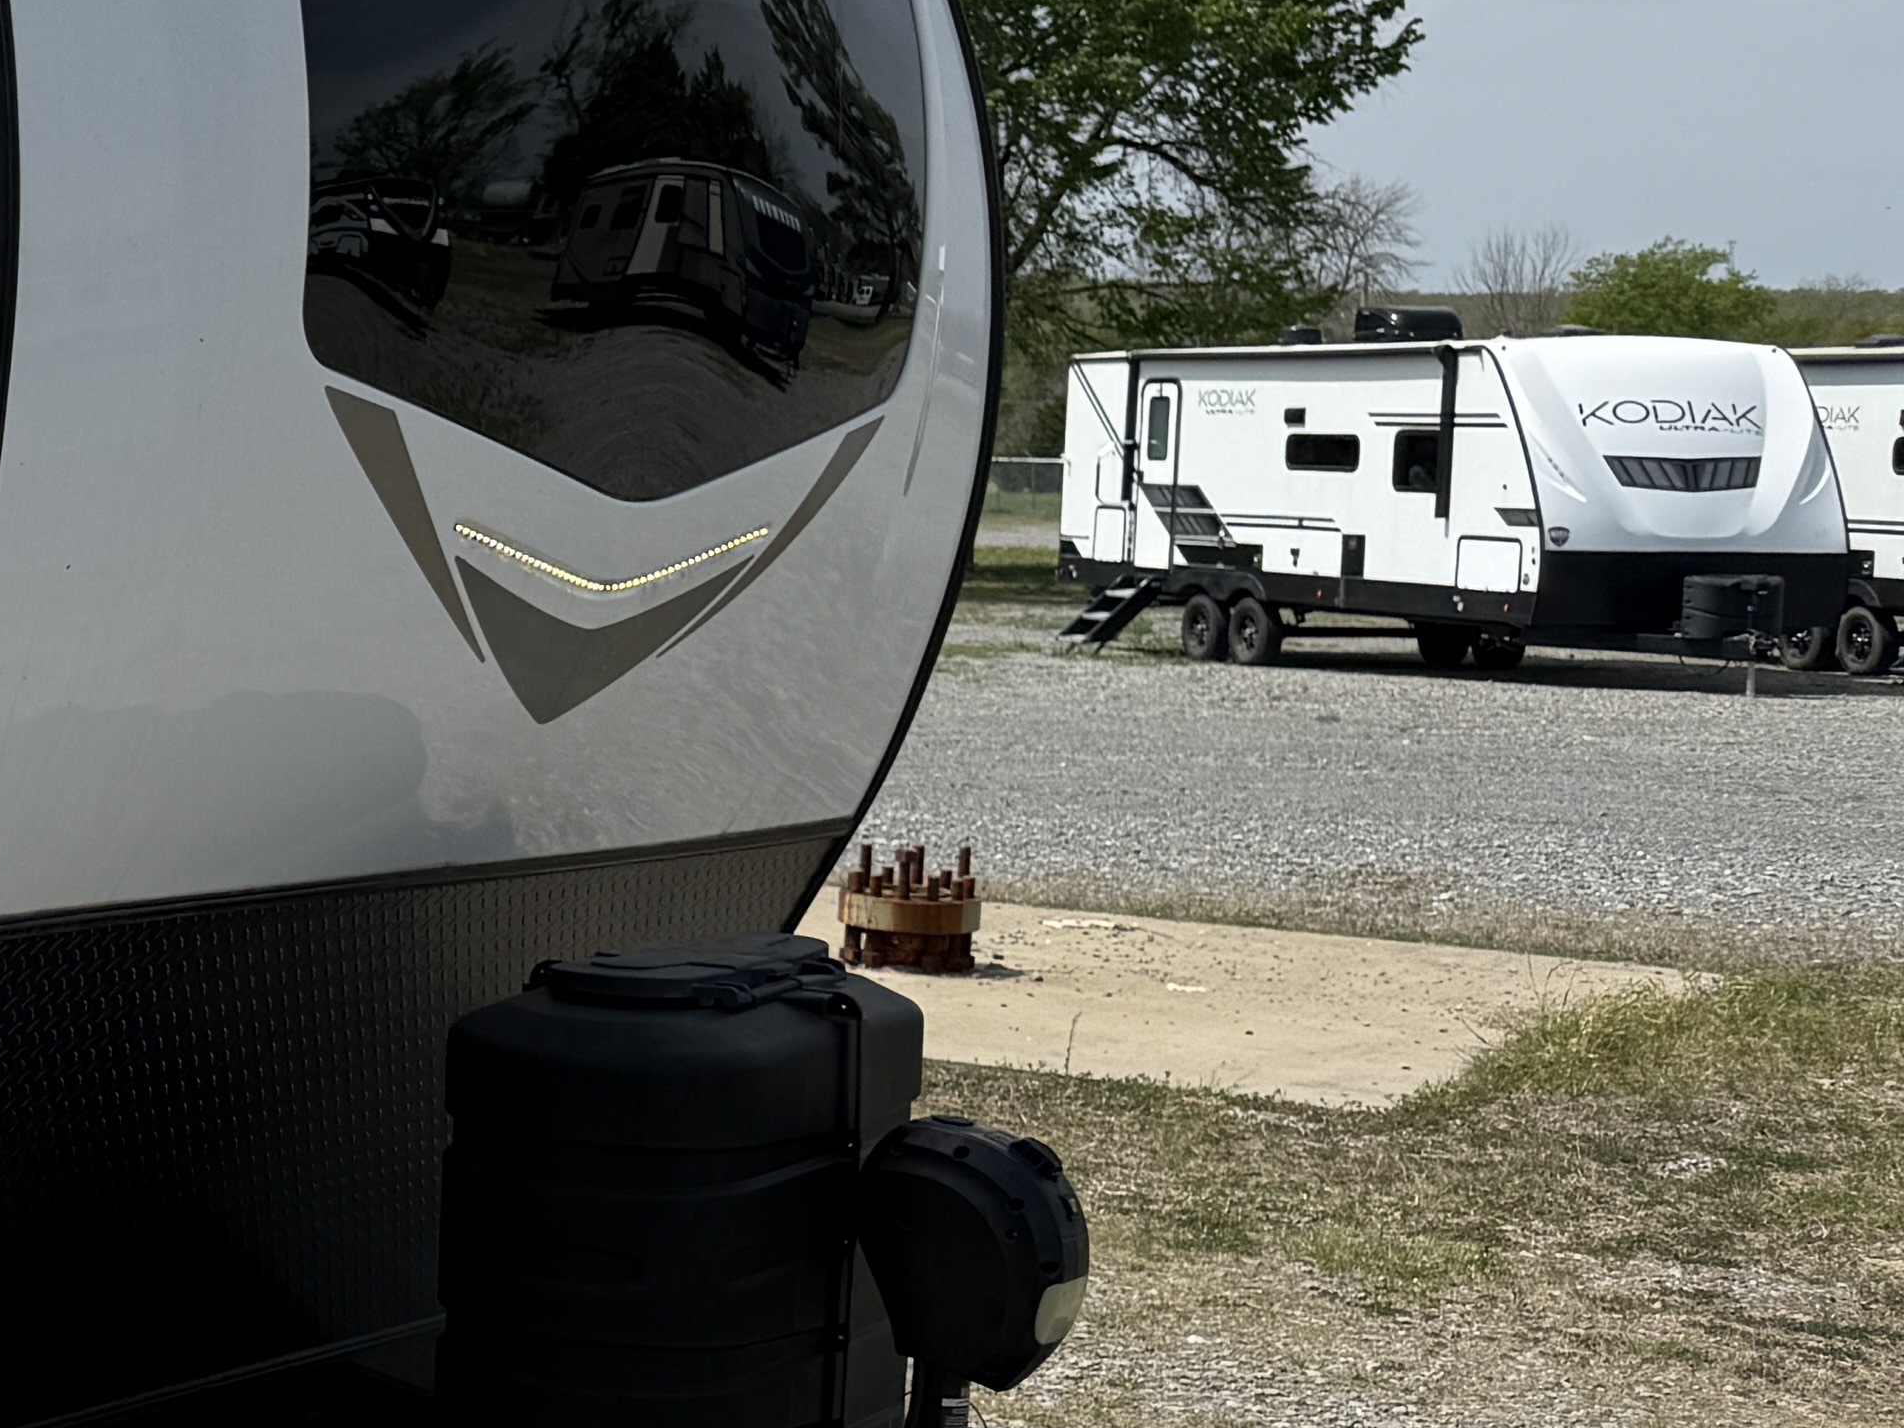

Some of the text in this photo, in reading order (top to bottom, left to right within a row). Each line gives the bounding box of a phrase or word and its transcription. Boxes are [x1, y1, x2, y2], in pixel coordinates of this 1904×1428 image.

[1198, 389, 1256, 407] KODIAK
[1578, 399, 1763, 430] KODIAK
[1816, 406, 1860, 424] DIAK
